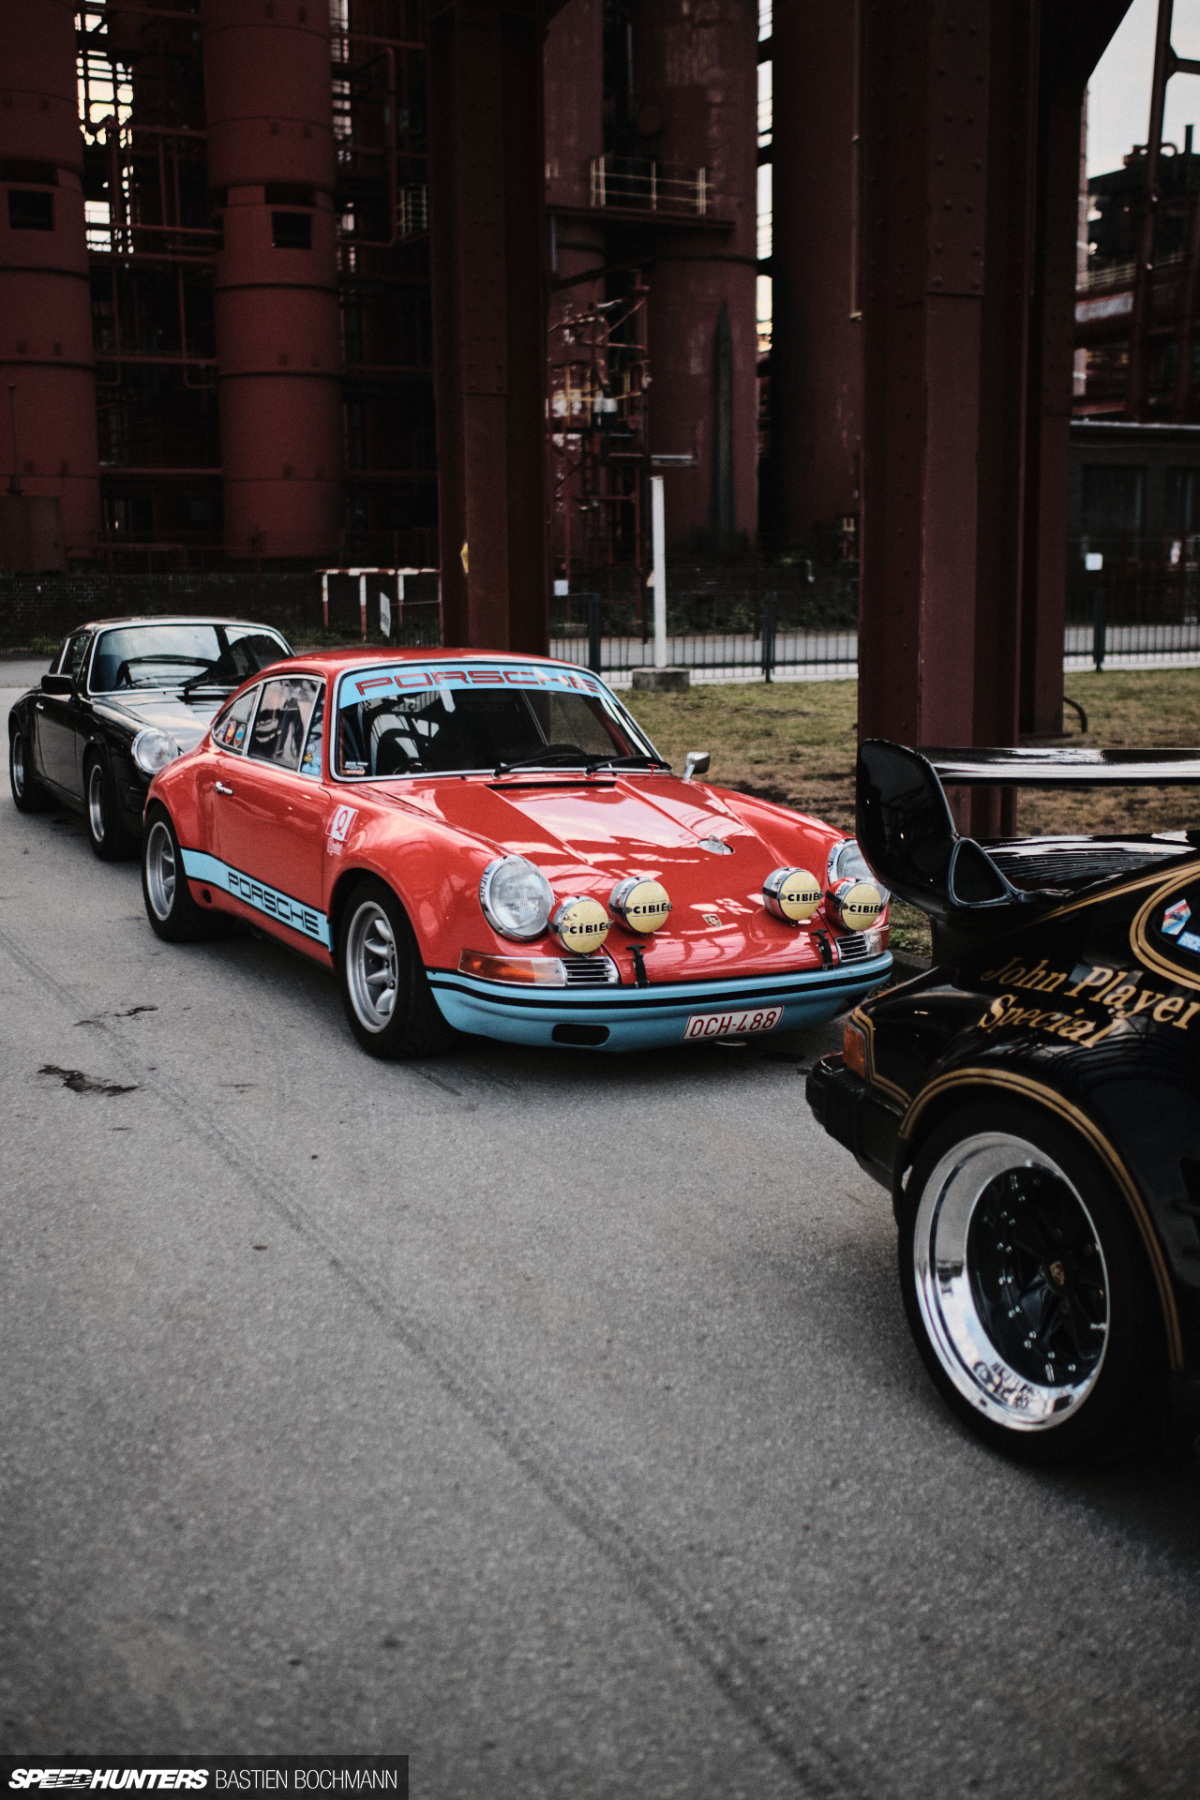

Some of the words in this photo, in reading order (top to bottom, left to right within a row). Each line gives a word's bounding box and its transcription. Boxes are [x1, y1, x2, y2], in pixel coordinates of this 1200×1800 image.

[355, 670, 600, 696] PORSCHE
[228, 871, 320, 936] PORSCHE
[980, 956, 1068, 993] John
[689, 1010, 777, 1038] OCH-488
[976, 993, 1128, 1049] Special
